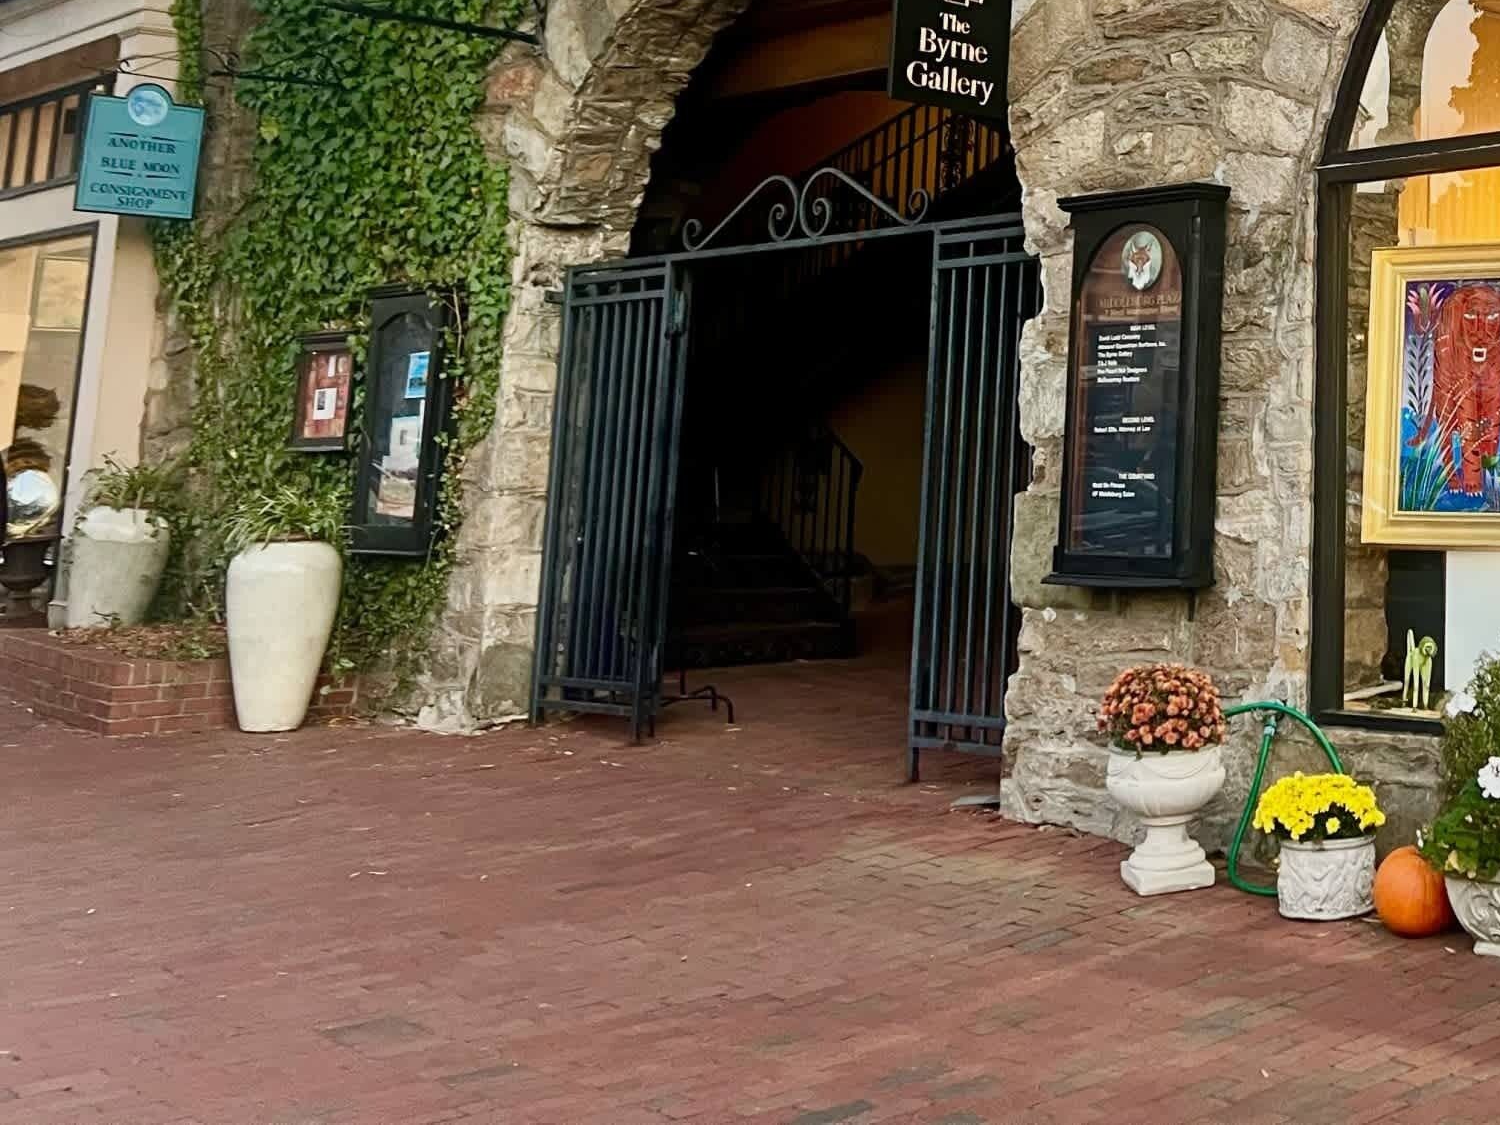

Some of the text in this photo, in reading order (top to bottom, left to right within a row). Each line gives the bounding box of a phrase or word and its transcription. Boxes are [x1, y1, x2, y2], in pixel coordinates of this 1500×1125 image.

[939, 11, 971, 35] The
[919, 26, 989, 64] Byrne
[906, 60, 994, 106] Gallery
[107, 137, 177, 155] ANOTHER
[100, 156, 181, 174] BLUE MOON
[89, 182, 189, 201] CONSIGNMENT
[116, 196, 155, 209] SHOP
